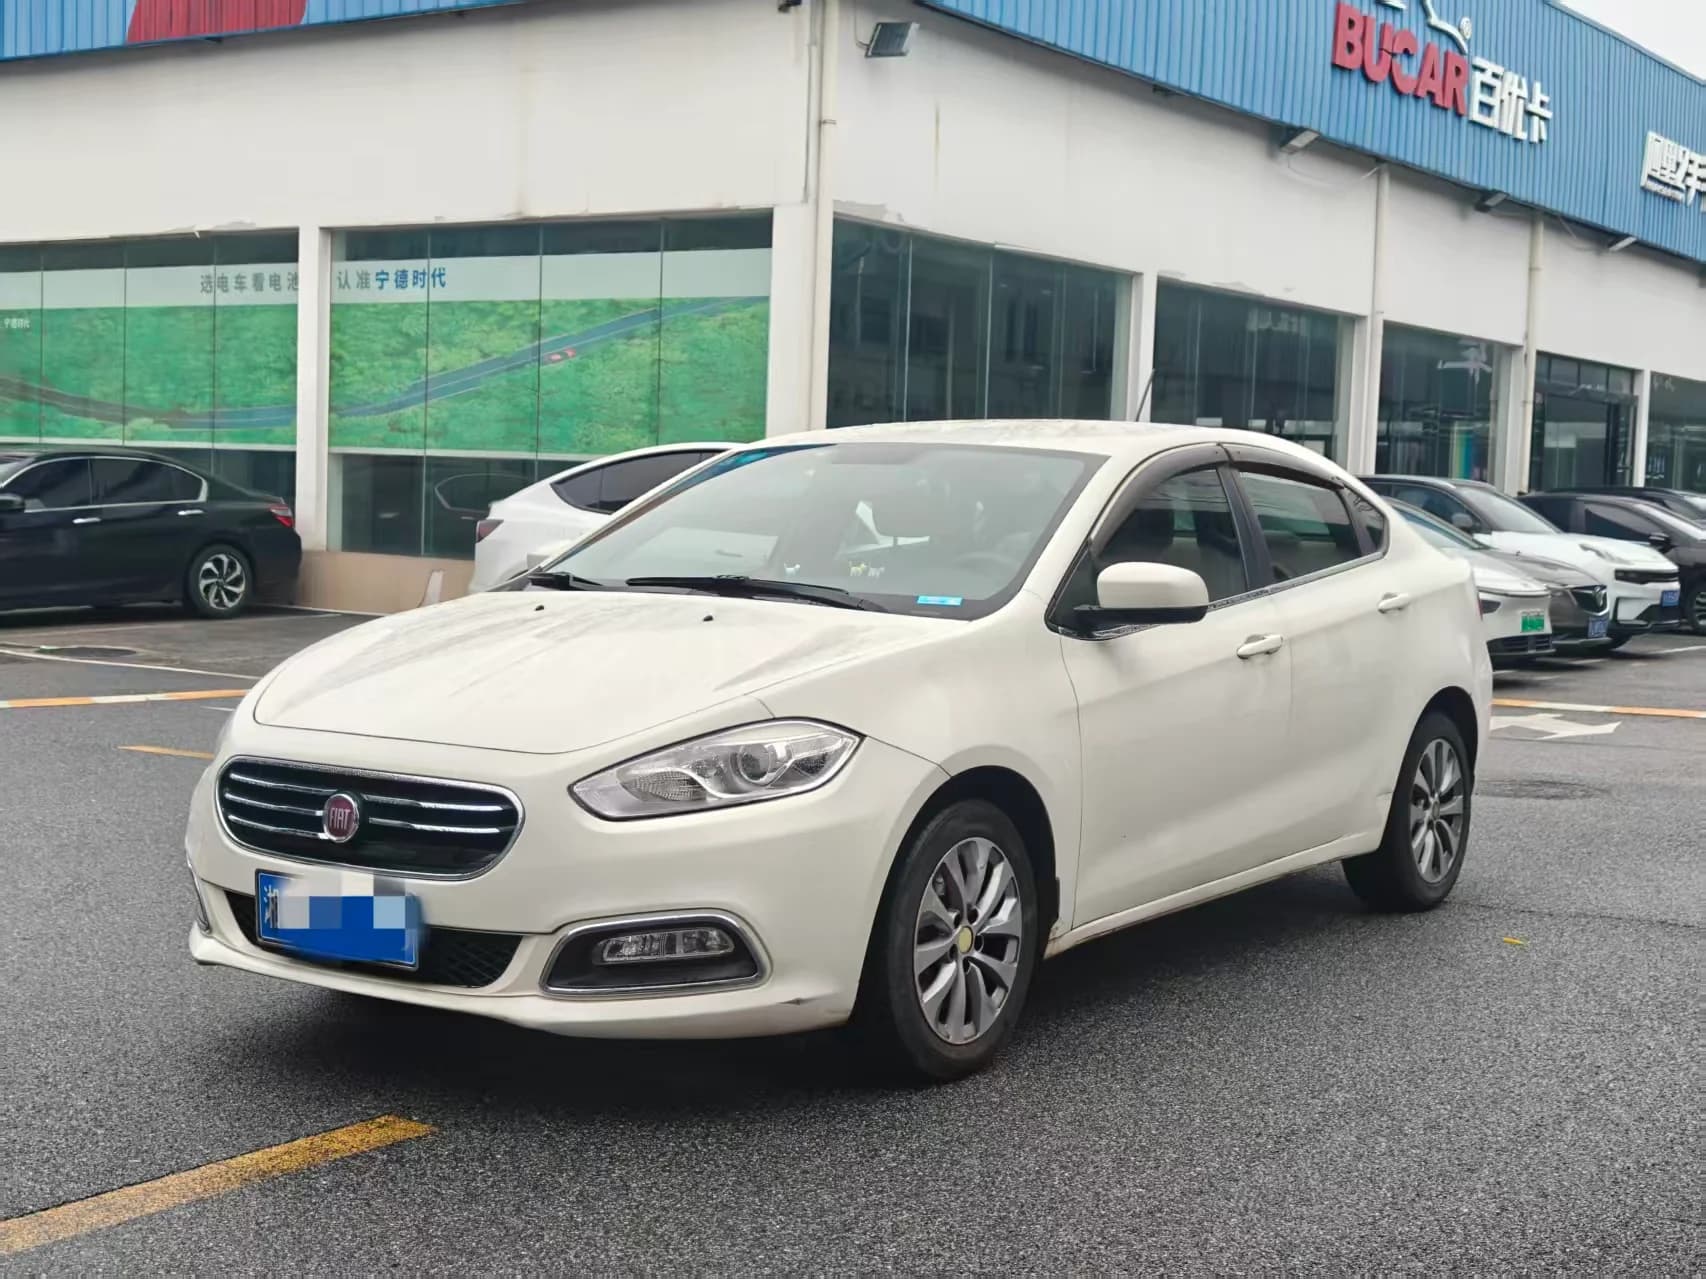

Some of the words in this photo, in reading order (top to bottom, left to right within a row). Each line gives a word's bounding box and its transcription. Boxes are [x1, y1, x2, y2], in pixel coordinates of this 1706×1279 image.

[1332, 2, 1469, 116] BUCAR
[1469, 55, 1553, 144] 百优卡
[199, 271, 298, 294] 选电车看电池
[336, 266, 447, 291] 认准宁德时代
[329, 807, 351, 830] FIAT
